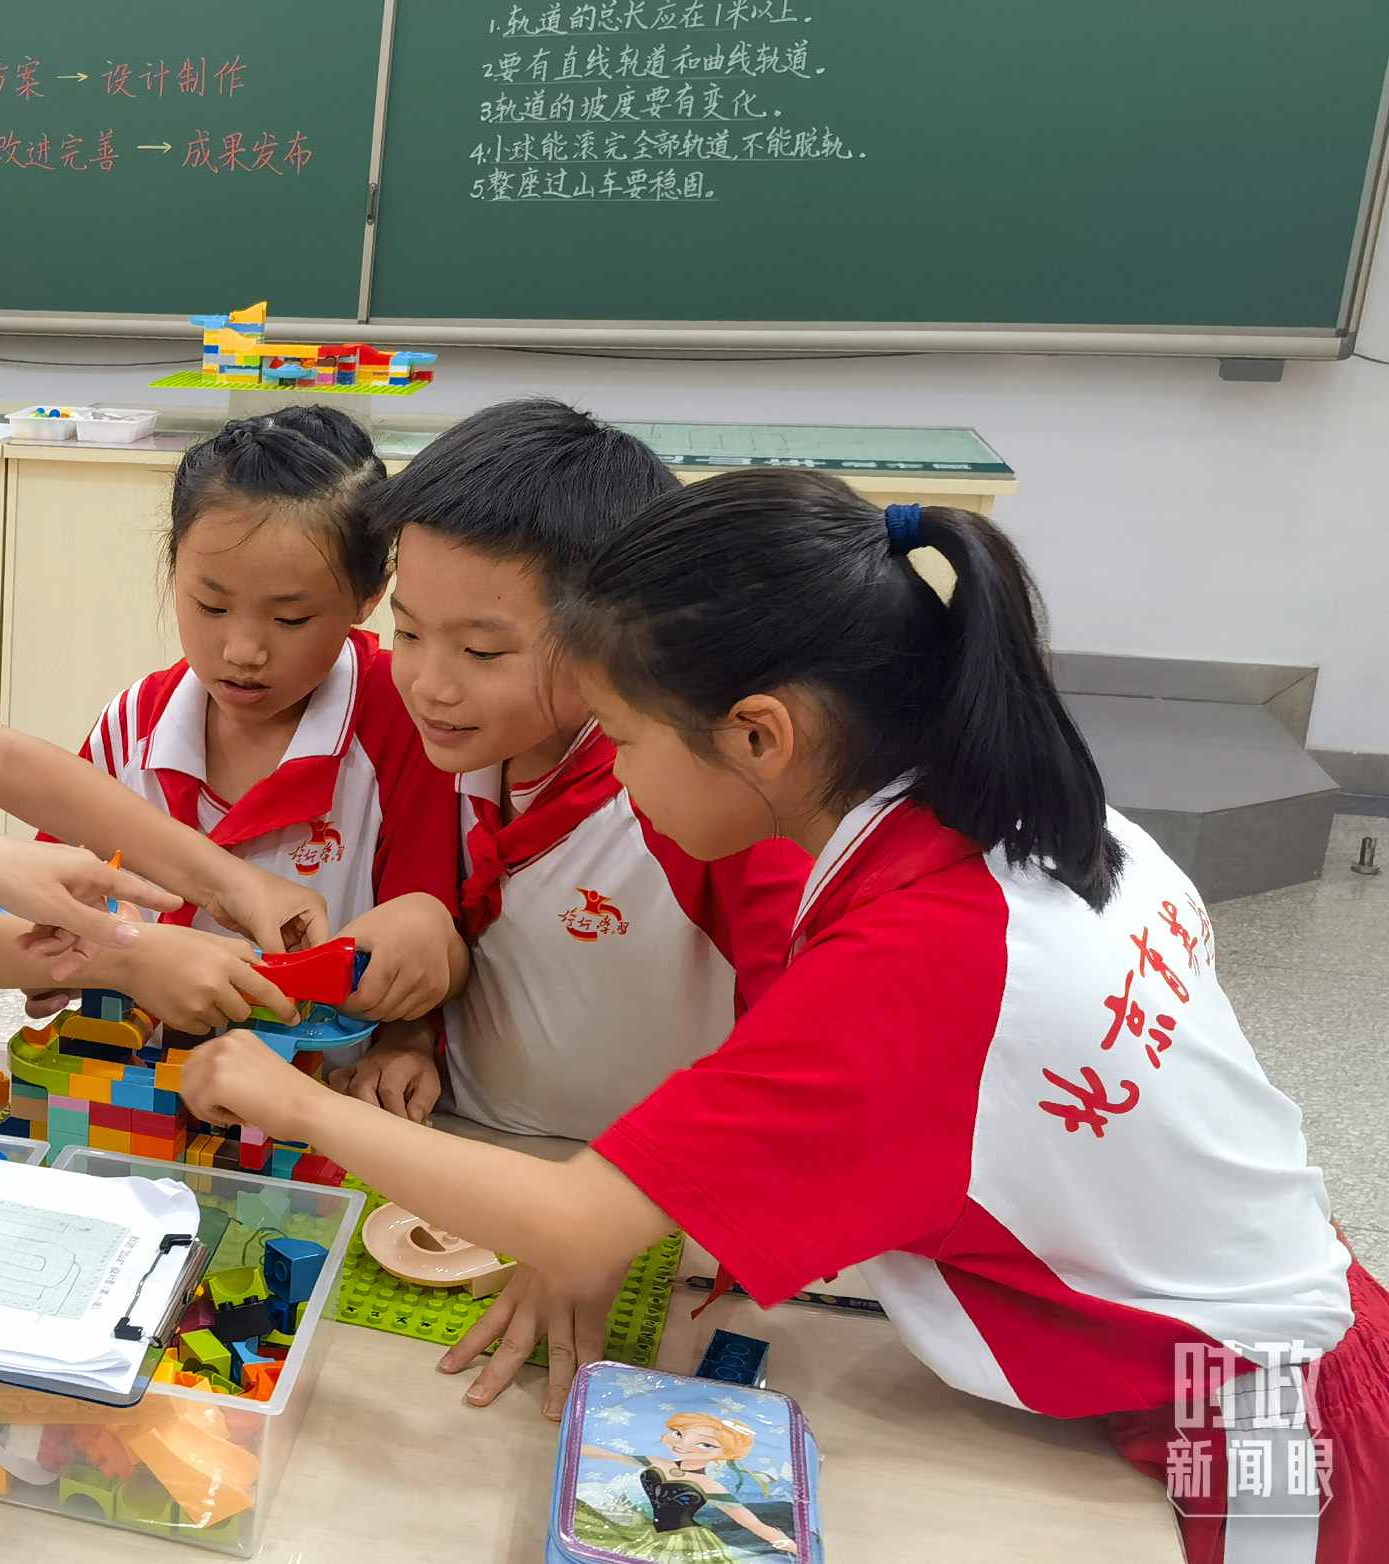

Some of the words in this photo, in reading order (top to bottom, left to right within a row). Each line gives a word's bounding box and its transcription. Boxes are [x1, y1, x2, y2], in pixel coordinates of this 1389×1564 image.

[101, 54, 247, 98] 设计制作
[181, 129, 312, 175] 成果发布
